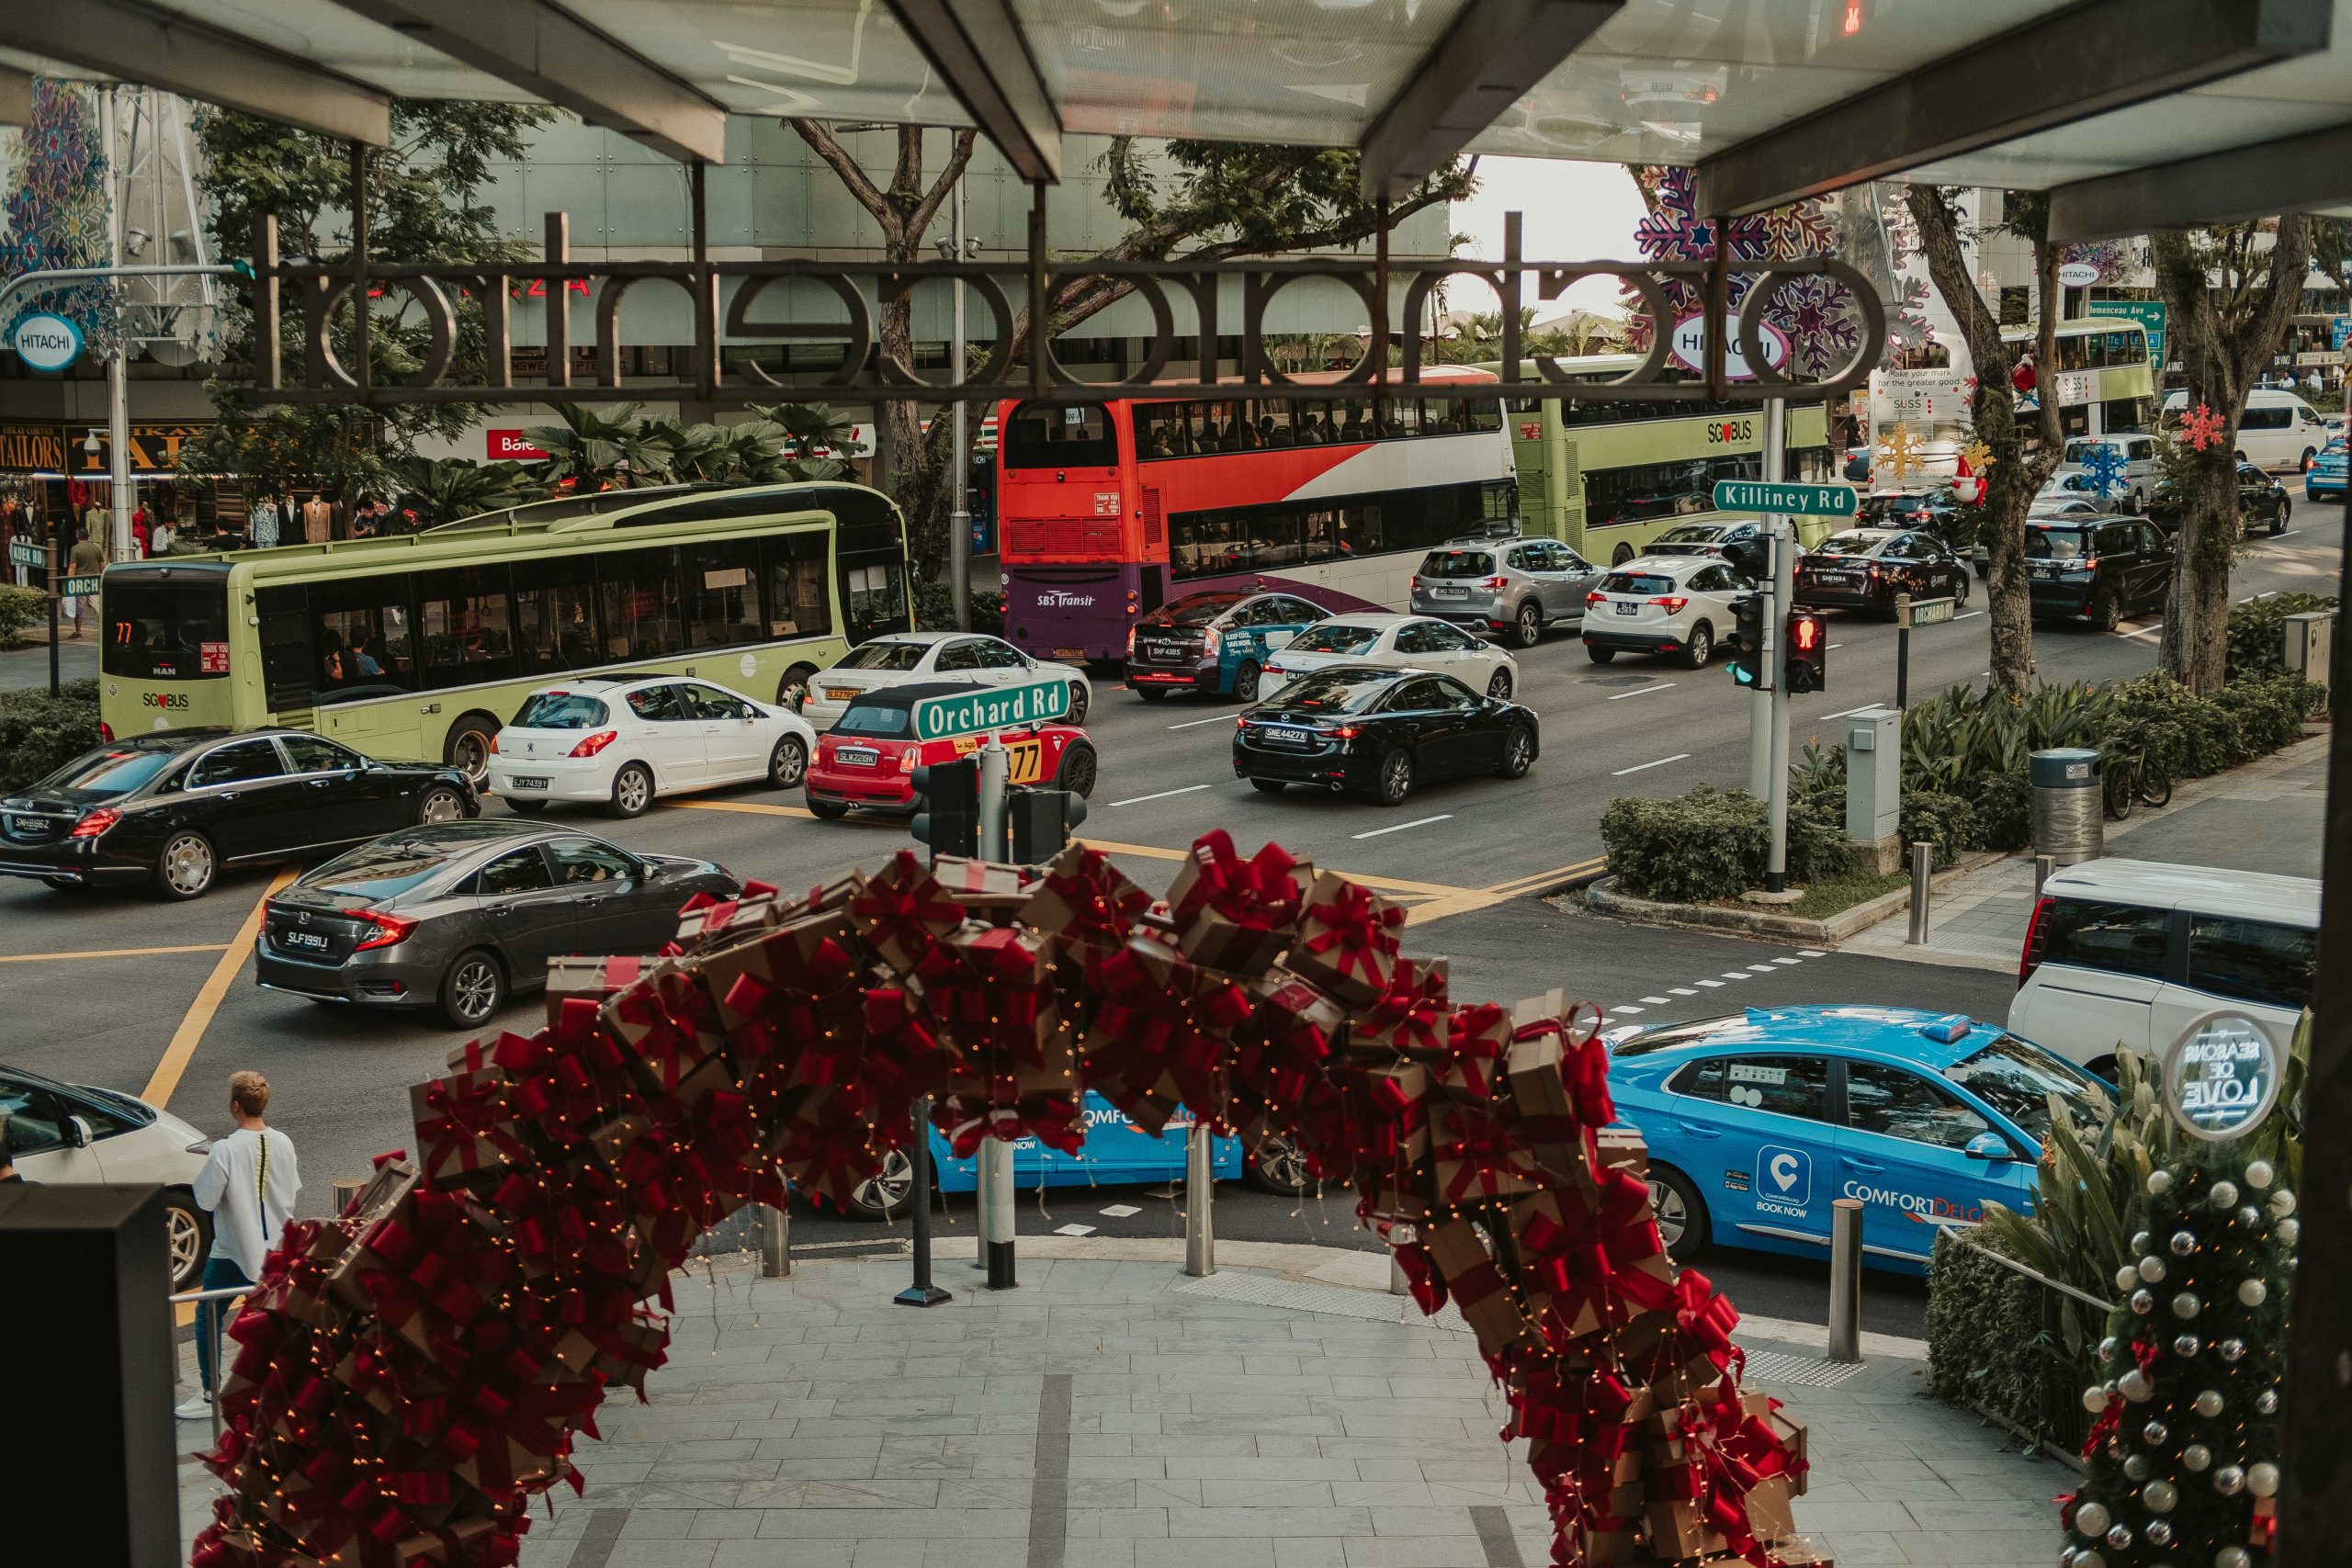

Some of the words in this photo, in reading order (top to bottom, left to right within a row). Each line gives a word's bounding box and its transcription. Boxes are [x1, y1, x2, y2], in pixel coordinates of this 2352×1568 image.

[2090, 306, 2127, 314] lemenceau
[2131, 306, 2144, 314] Ave
[21, 334, 70, 349] HITACHI
[1907, 378, 1936, 388] greater
[1894, 399, 1921, 409] SUSS
[0, 435, 62, 468] TAILORS
[1725, 486, 1809, 512] Killiney
[1819, 490, 1844, 509] Rd
[13, 545, 30, 563] KOEK
[33, 550, 42, 564] RD
[68, 578, 99, 594] ORCH
[1037, 595, 1055, 606] SBS
[1054, 592, 1096, 608] Transit
[1915, 604, 1945, 624] ORCHARD
[116, 622, 132, 644] 77
[153, 667, 176, 676] MAN
[929, 696, 1024, 734] Orchard
[1033, 685, 1059, 716] Rd
[1266, 728, 1306, 740] SME4427X
[839, 751, 875, 763] SLW2219K
[514, 778, 547, 788] SJY7439Y
[288, 931, 328, 948] SLF1991J
[1756, 1201, 1783, 1214] BOOK
[1783, 1207, 1808, 1219] NOW
